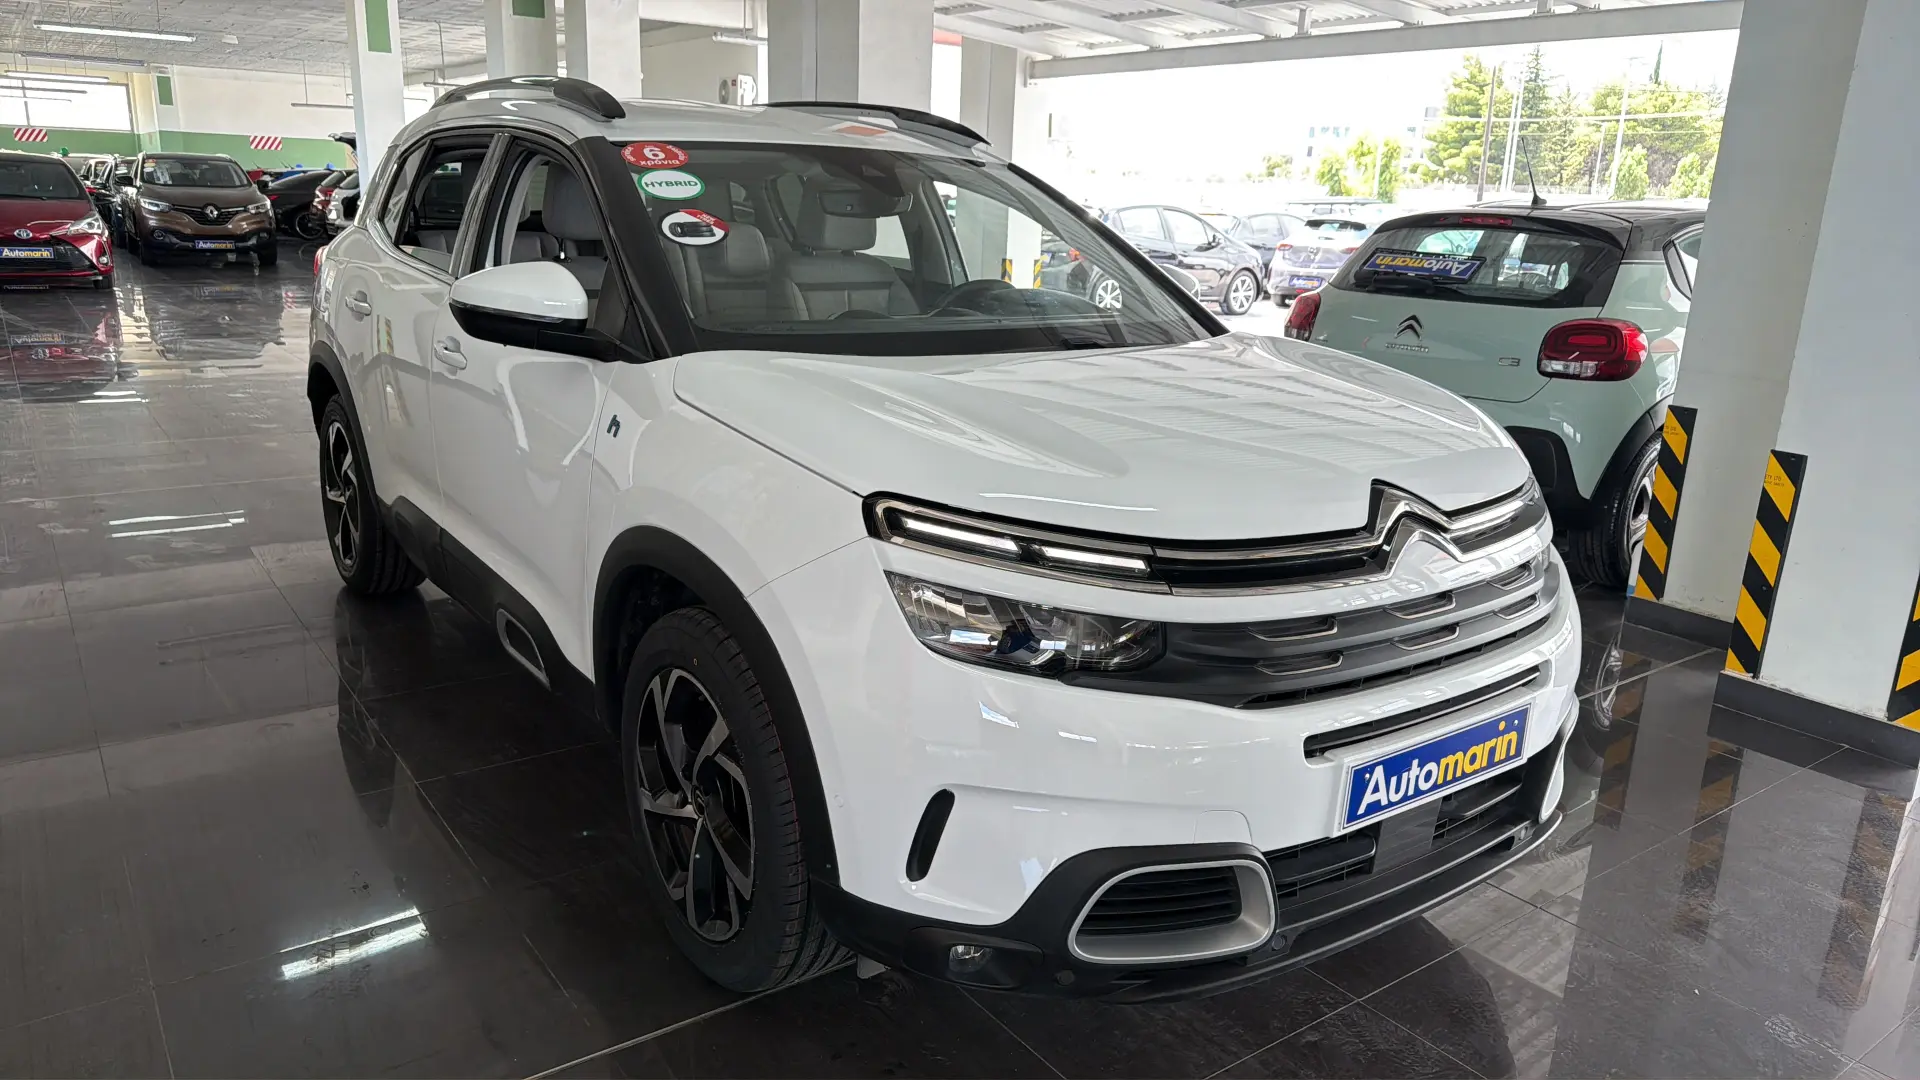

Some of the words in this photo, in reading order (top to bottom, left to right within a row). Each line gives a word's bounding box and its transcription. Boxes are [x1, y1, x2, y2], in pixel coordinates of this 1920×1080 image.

[643, 147, 666, 160] 6
[2, 248, 50, 257] Automarin
[1376, 255, 1471, 275] Automarin
[1499, 357, 1520, 366] C3
[1356, 720, 1518, 815] Automarin
